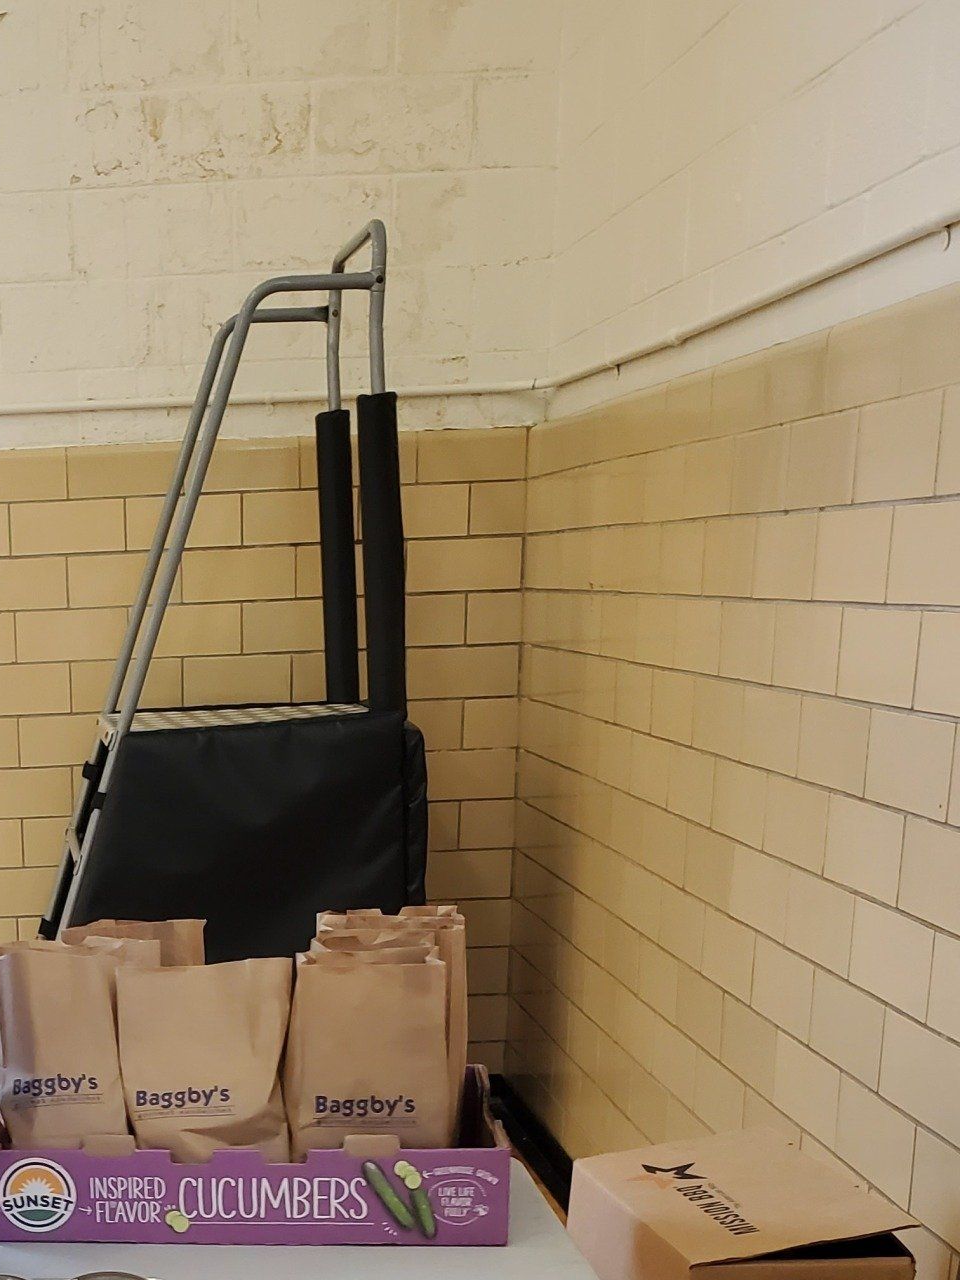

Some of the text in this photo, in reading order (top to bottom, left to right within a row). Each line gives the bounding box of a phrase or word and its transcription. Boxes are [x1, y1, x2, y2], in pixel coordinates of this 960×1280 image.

[12, 1074, 98, 1096] Baggby's
[135, 1085, 230, 1108] Baggby's
[315, 1095, 415, 1116] Baggby's
[90, 1177, 166, 1199] INSPIRED
[178, 1177, 368, 1219] CUCUMBERS
[676, 1184, 715, 1201] BBQ
[2, 1194, 73, 1212] SUNSET
[96, 1201, 162, 1223] FLAVOR
[696, 1201, 760, 1235] MISSION
